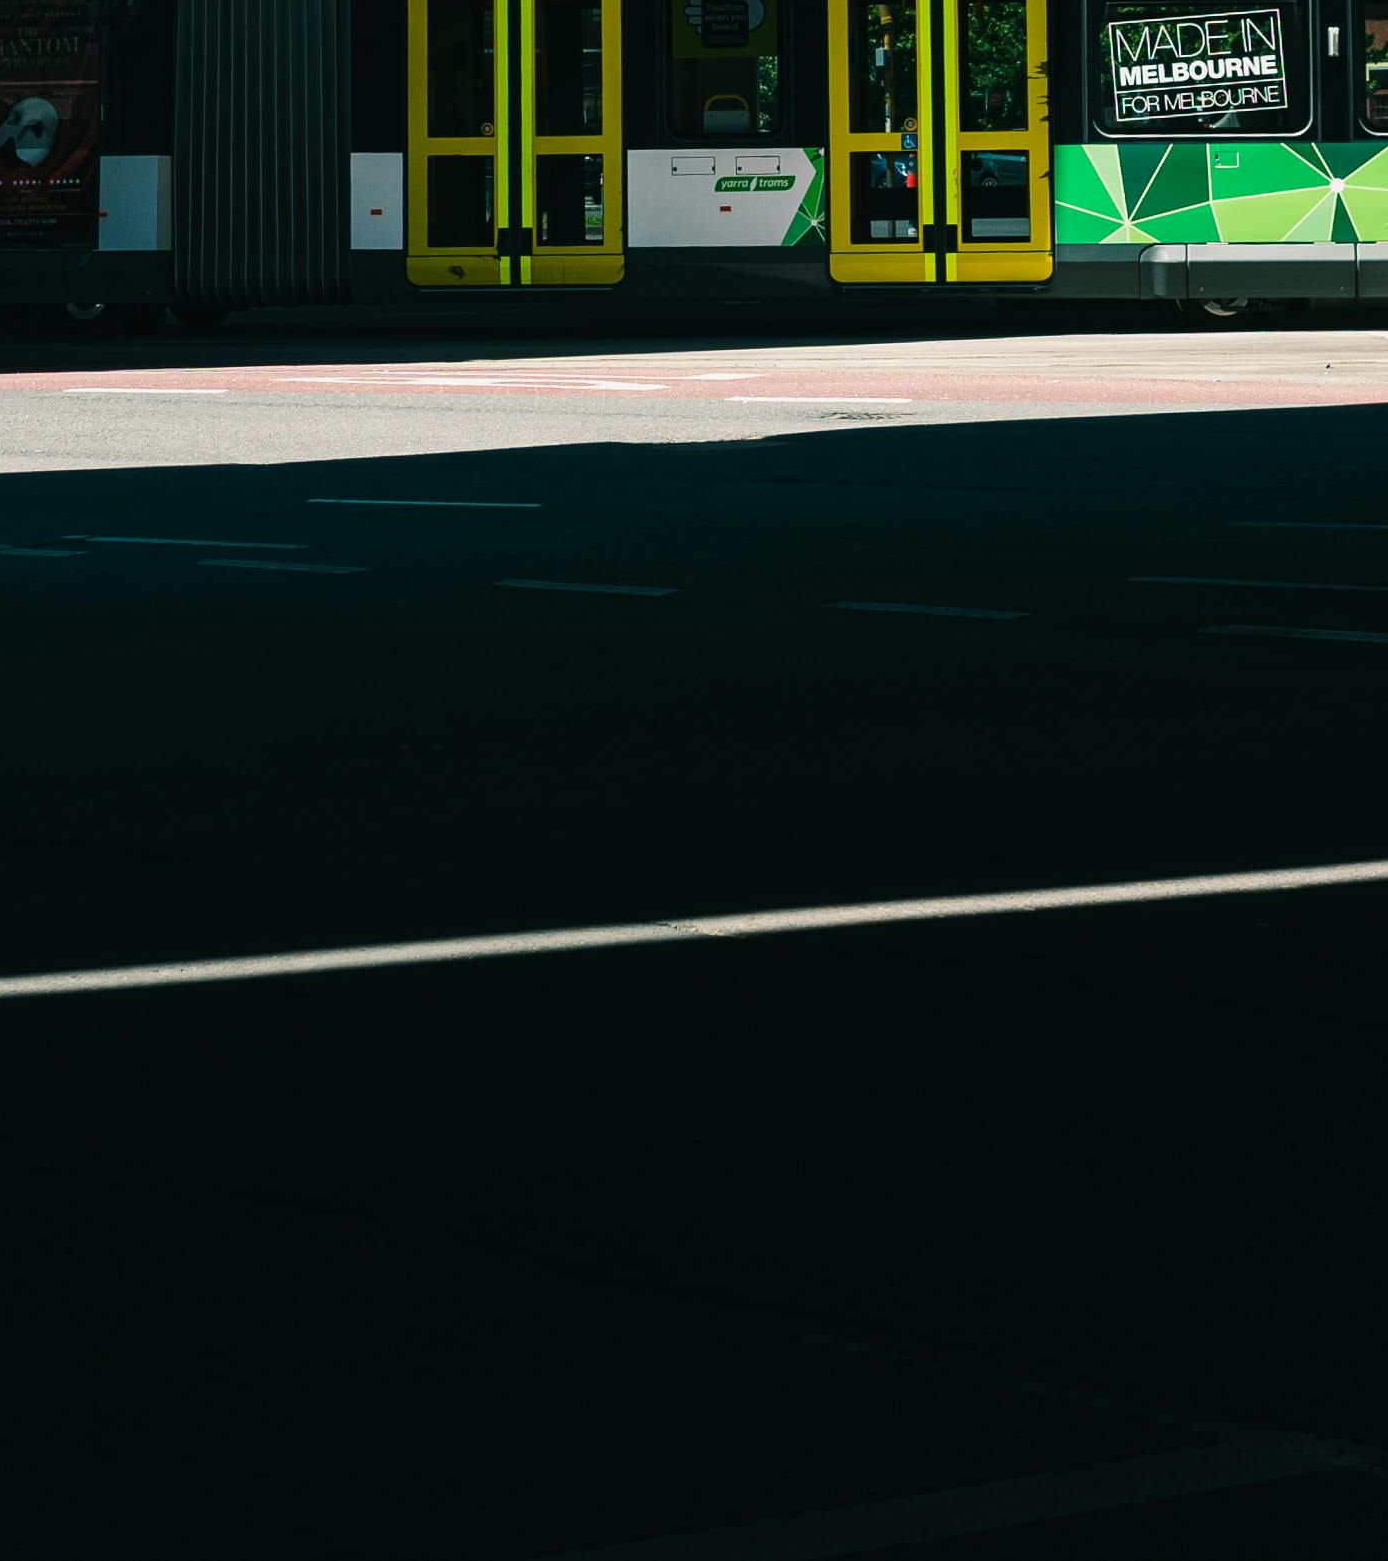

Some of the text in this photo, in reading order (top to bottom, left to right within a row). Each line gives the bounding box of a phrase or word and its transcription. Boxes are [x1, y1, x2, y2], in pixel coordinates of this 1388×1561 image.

[1115, 16, 1276, 63] MADE IN
[1118, 55, 1279, 87] MELBOURNE
[1121, 85, 1281, 115] FOR MELBOURNE
[721, 178, 789, 190] yarra trams
